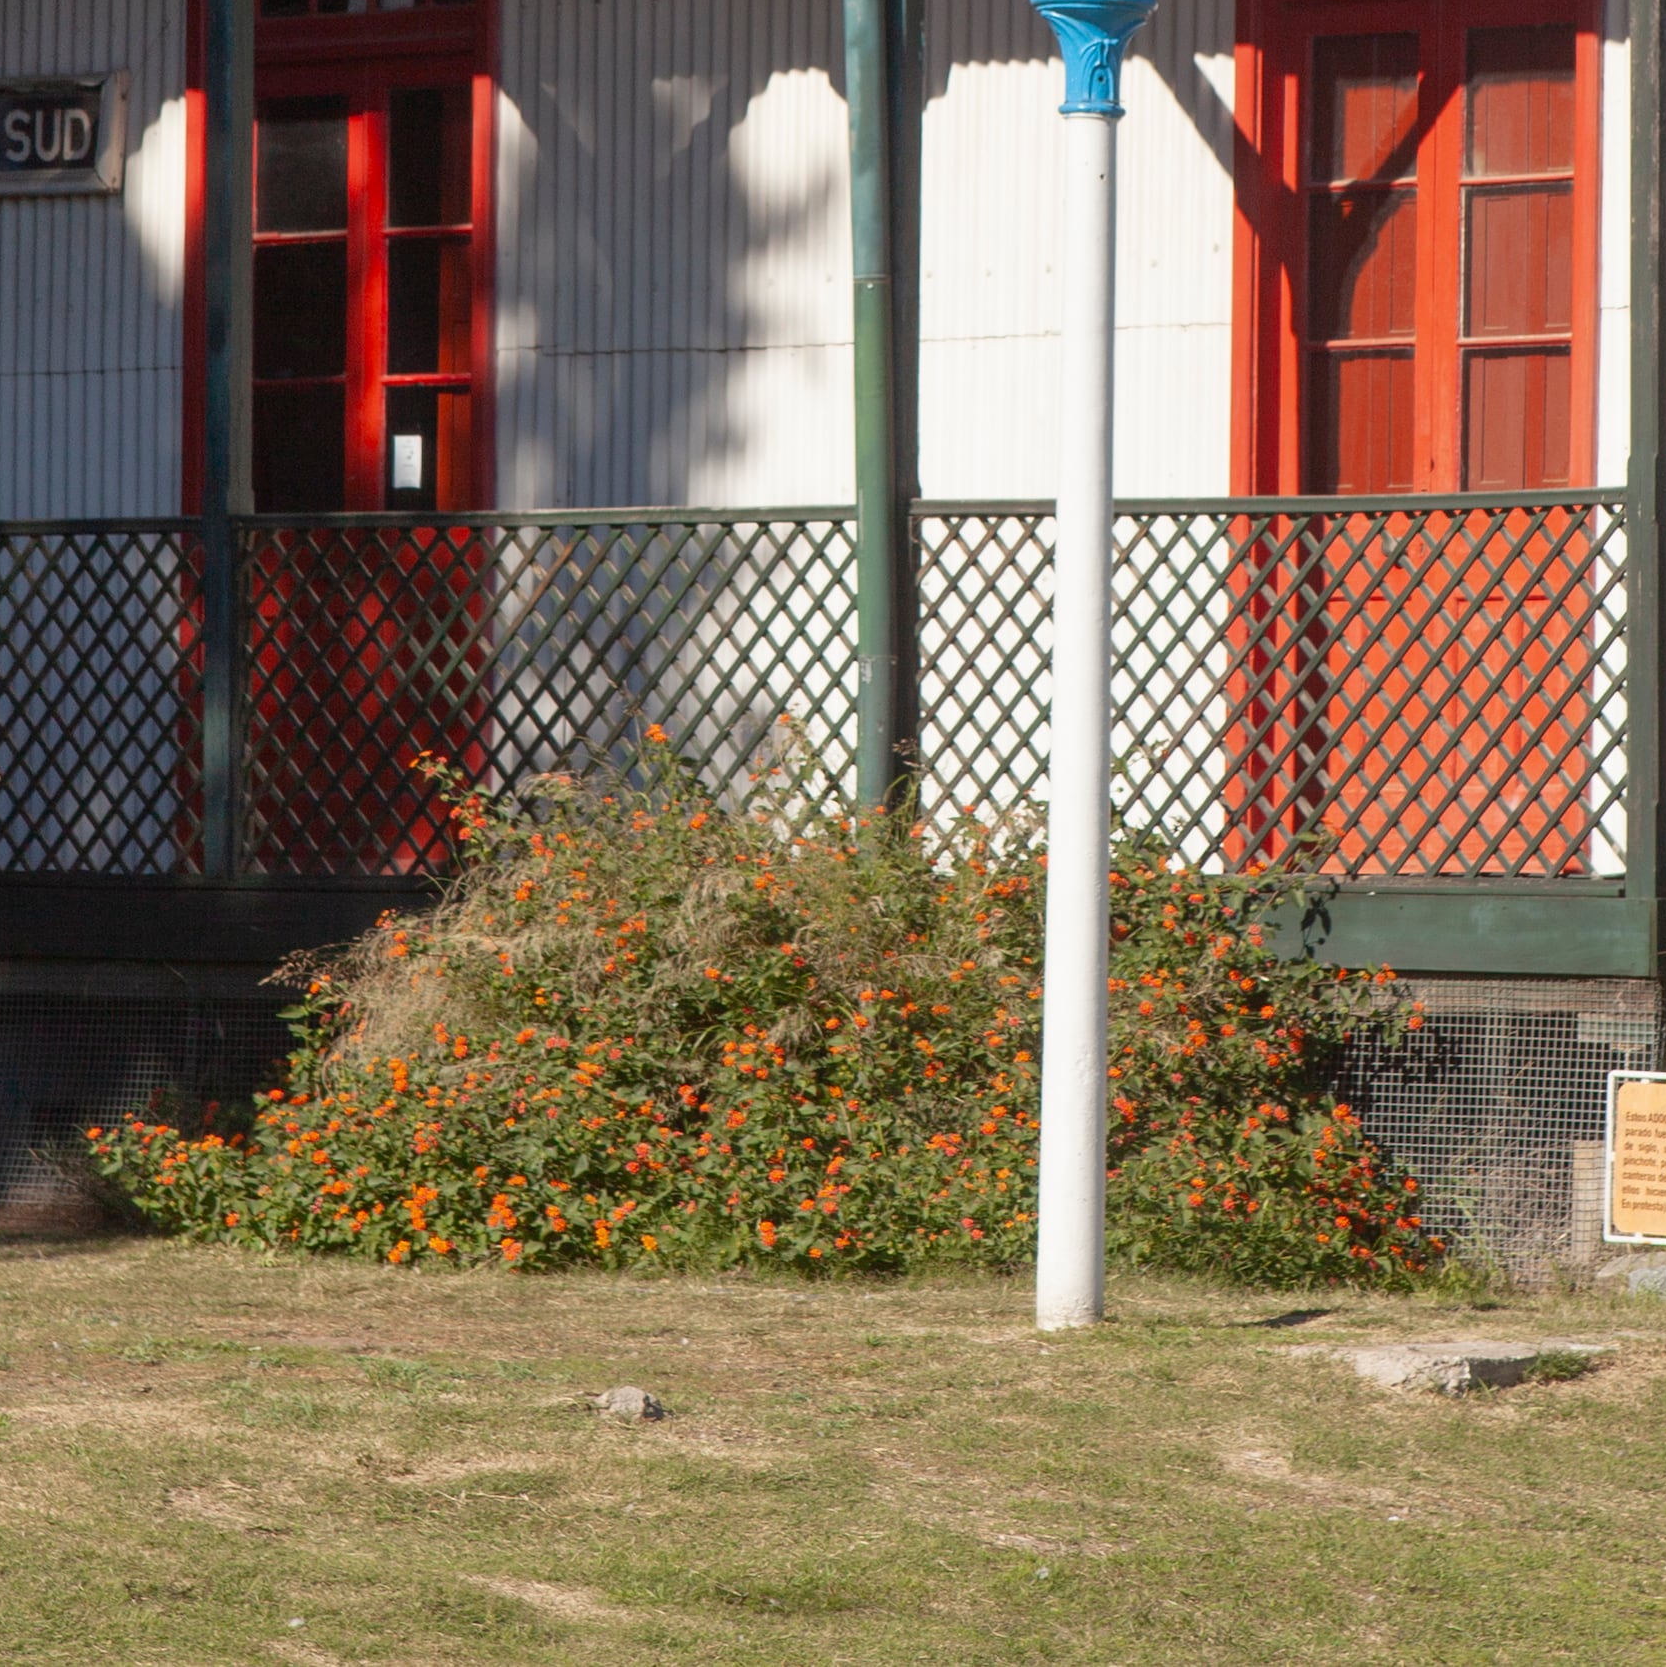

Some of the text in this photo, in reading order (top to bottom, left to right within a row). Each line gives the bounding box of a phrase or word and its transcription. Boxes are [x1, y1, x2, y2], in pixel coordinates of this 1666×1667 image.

[4, 108, 91, 163] SUD
[1626, 1111, 1647, 1123] Estos
[1625, 1127, 1652, 1138] parado
[1624, 1142, 1633, 1151] de
[1622, 1171, 1656, 1182] canteras
[1658, 1173, 1666, 1183] de
[1621, 1198, 1631, 1209] En
